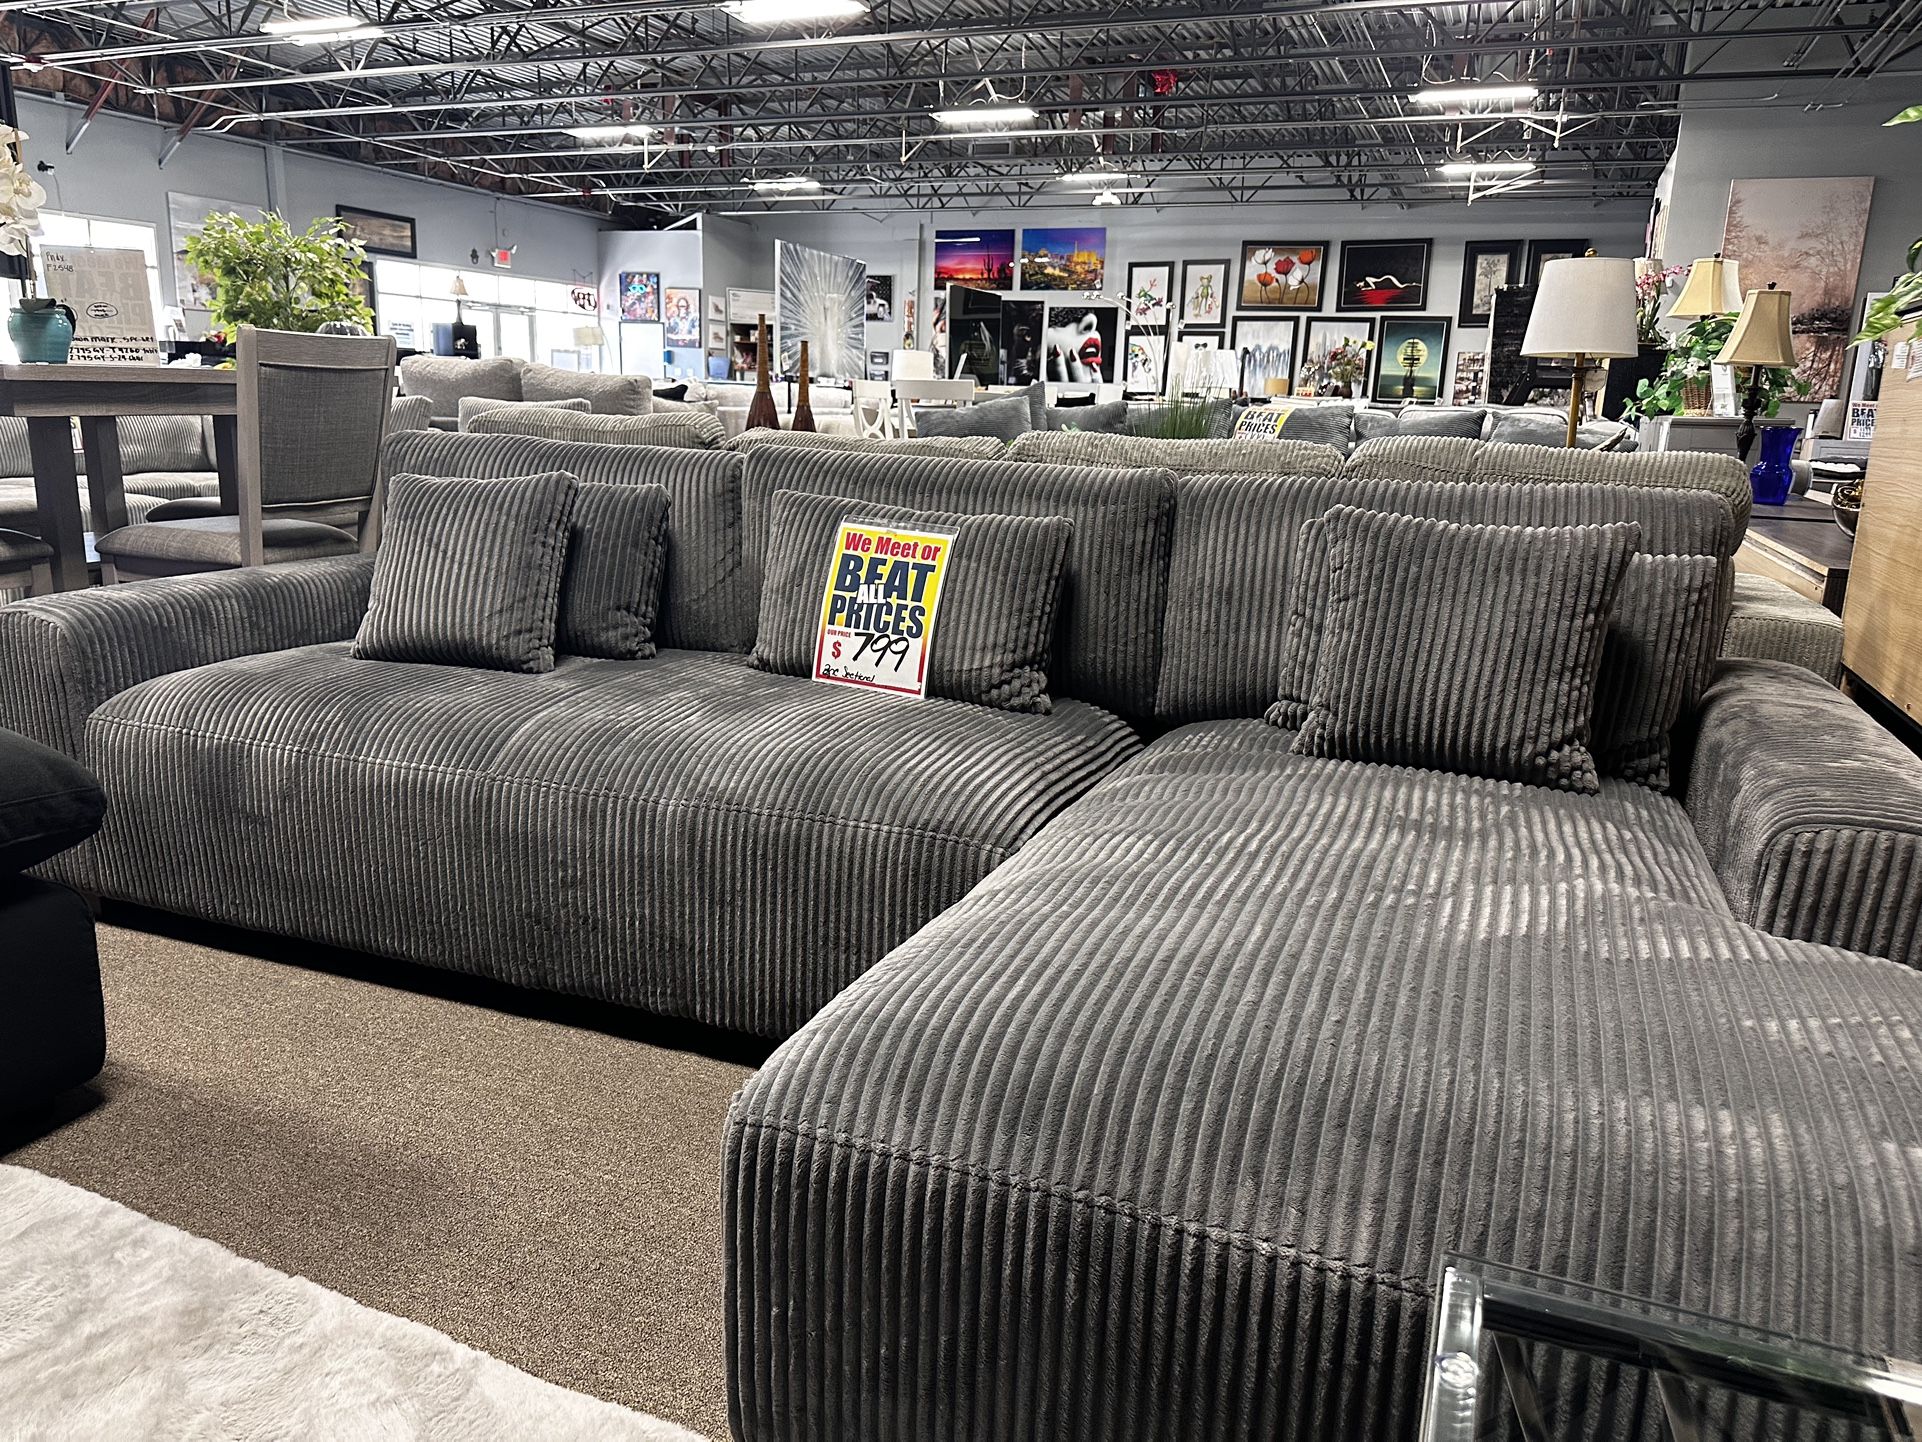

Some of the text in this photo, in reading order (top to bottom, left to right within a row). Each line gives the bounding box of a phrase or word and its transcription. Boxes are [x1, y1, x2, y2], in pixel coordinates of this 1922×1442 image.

[1239, 421, 1278, 434] PRICES
[1244, 410, 1285, 423] BEAT
[844, 532, 941, 562] We Meet or
[834, 552, 936, 603] BEAT
[856, 583, 888, 604] ALL
[827, 594, 926, 639] PRICES
[838, 630, 852, 638] PRICE
[832, 632, 910, 673] $ 799
